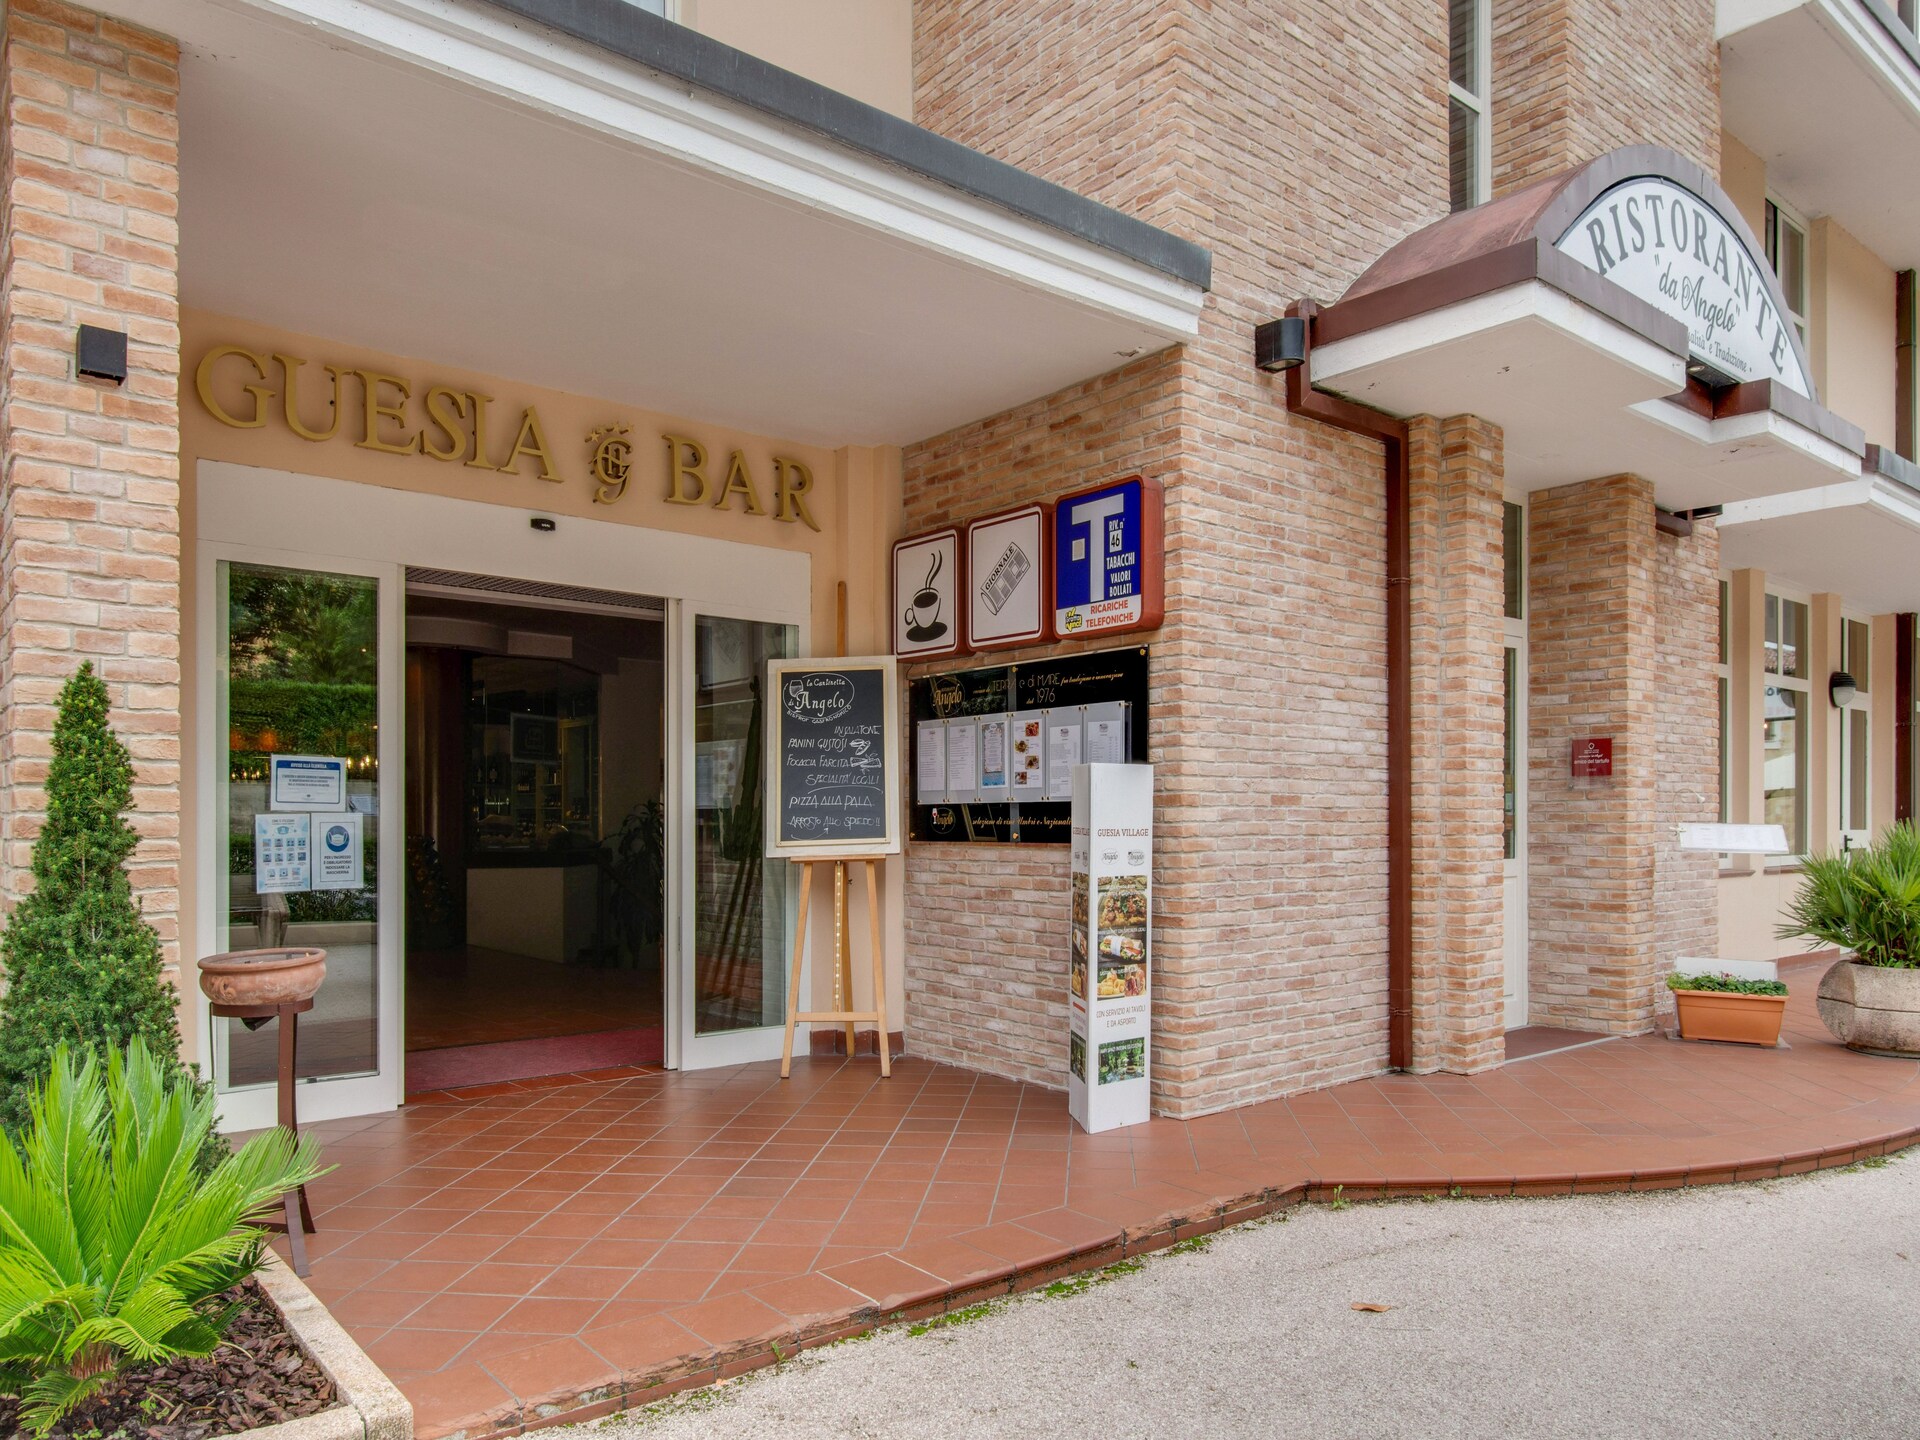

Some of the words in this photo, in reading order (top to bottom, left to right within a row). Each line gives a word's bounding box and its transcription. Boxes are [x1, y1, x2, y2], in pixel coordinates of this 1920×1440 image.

[1586, 194, 1788, 375] RISTORANTE
[1714, 341, 1748, 372] Tradizione
[195, 344, 565, 484] GUESIA
[662, 432, 821, 533] BAR
[1110, 533, 1121, 548] 46
[985, 545, 1014, 590] GIORNALE
[1106, 551, 1136, 570] TABACCHI
[1110, 570, 1131, 584] VALORI
[1109, 583, 1133, 597] BOLLATI
[1090, 599, 1129, 614] RICARICHE
[1085, 612, 1134, 628] TELEFONICHE
[1037, 672, 1061, 687] MARE
[932, 682, 963, 713] Angelo
[1036, 687, 1056, 703] 1976
[795, 690, 845, 717] Angelo
[834, 724, 882, 738] INSALATONE
[787, 738, 815, 749] PANINI
[817, 738, 848, 753] GUSTOSI
[788, 794, 819, 809] PIZZA
[820, 795, 842, 806] ALLA
[844, 794, 873, 811] PALA
[823, 815, 841, 827] ALLO
[1097, 828, 1120, 837] GUESIA
[1121, 828, 1149, 837] VILLAGE
[1096, 1010, 1105, 1018] CON
[1106, 1007, 1125, 1017] SERVIZIO
[1131, 1005, 1146, 1013] TAVOLI
[1118, 1017, 1136, 1026] ASPORTO
